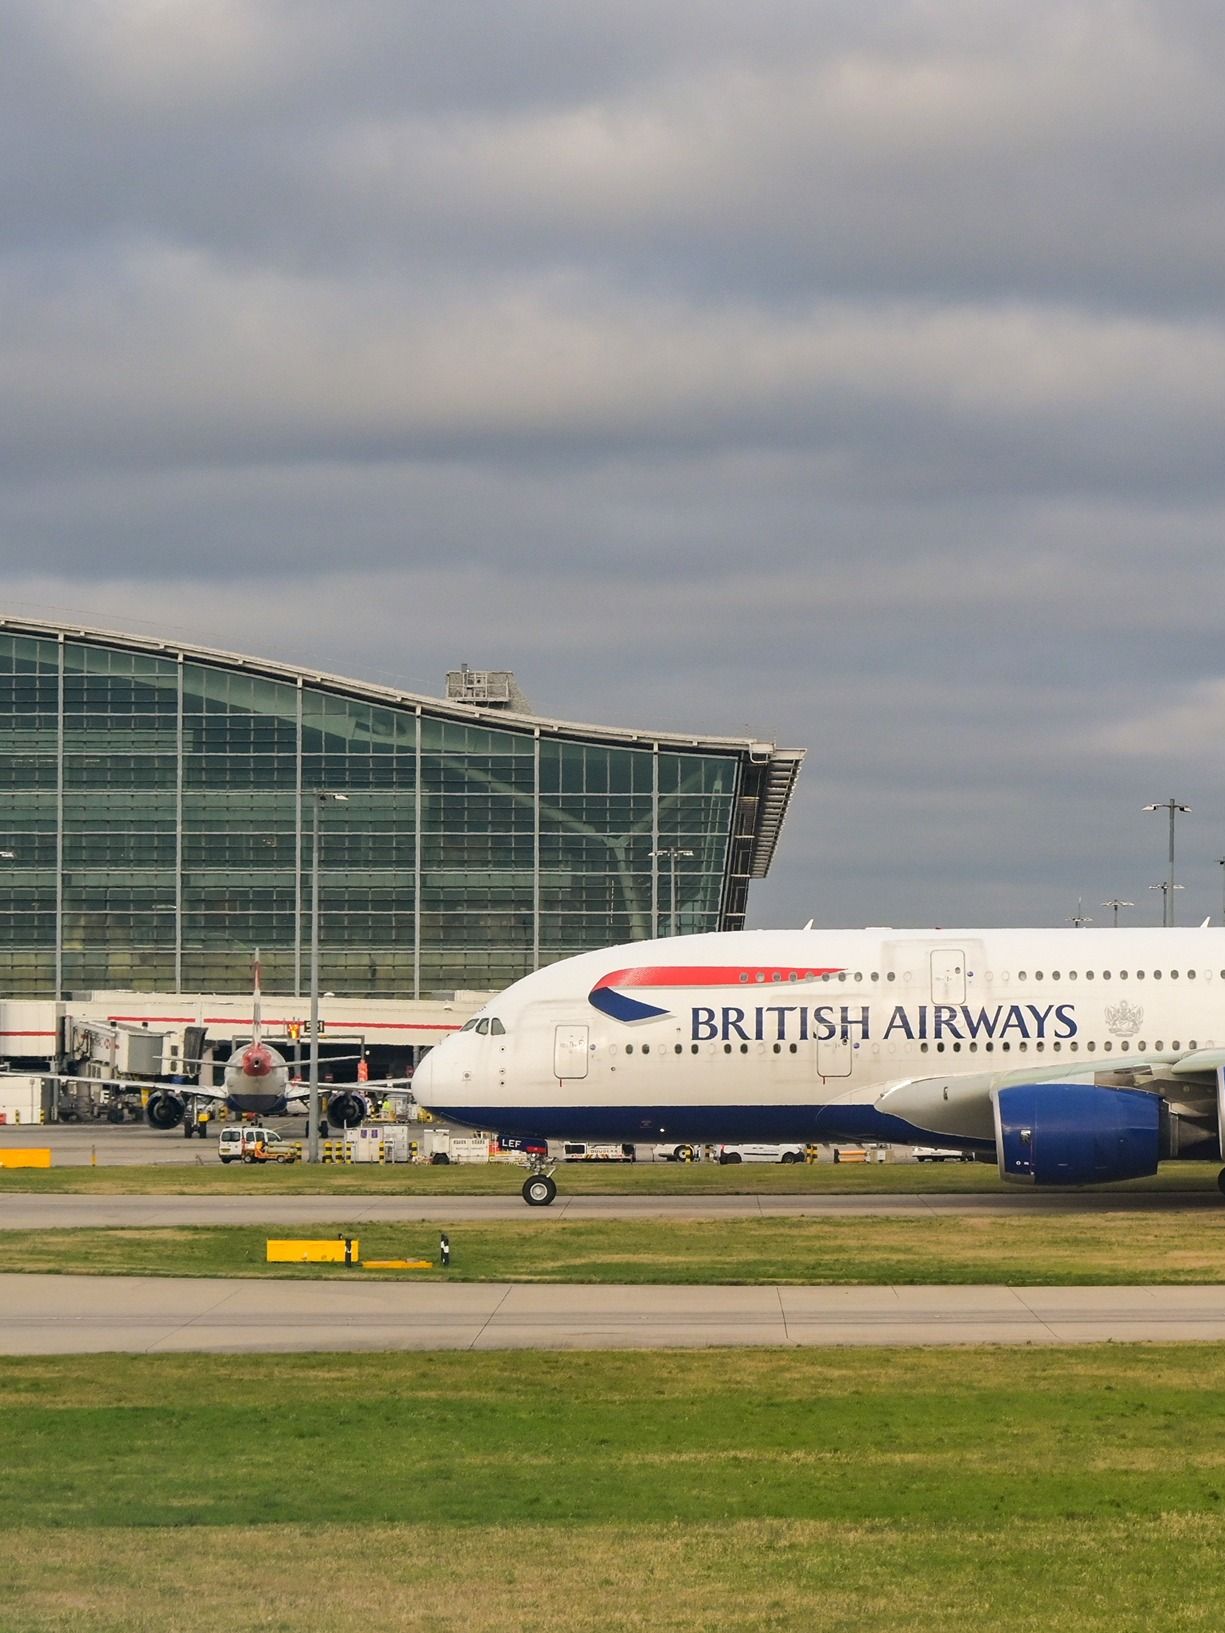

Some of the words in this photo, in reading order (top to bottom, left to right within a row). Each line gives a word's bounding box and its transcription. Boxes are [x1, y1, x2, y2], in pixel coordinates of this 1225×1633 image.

[691, 1006, 870, 1041] BRITISH
[883, 1004, 1078, 1040] AIRWAYS
[501, 1138, 522, 1148] LEF
